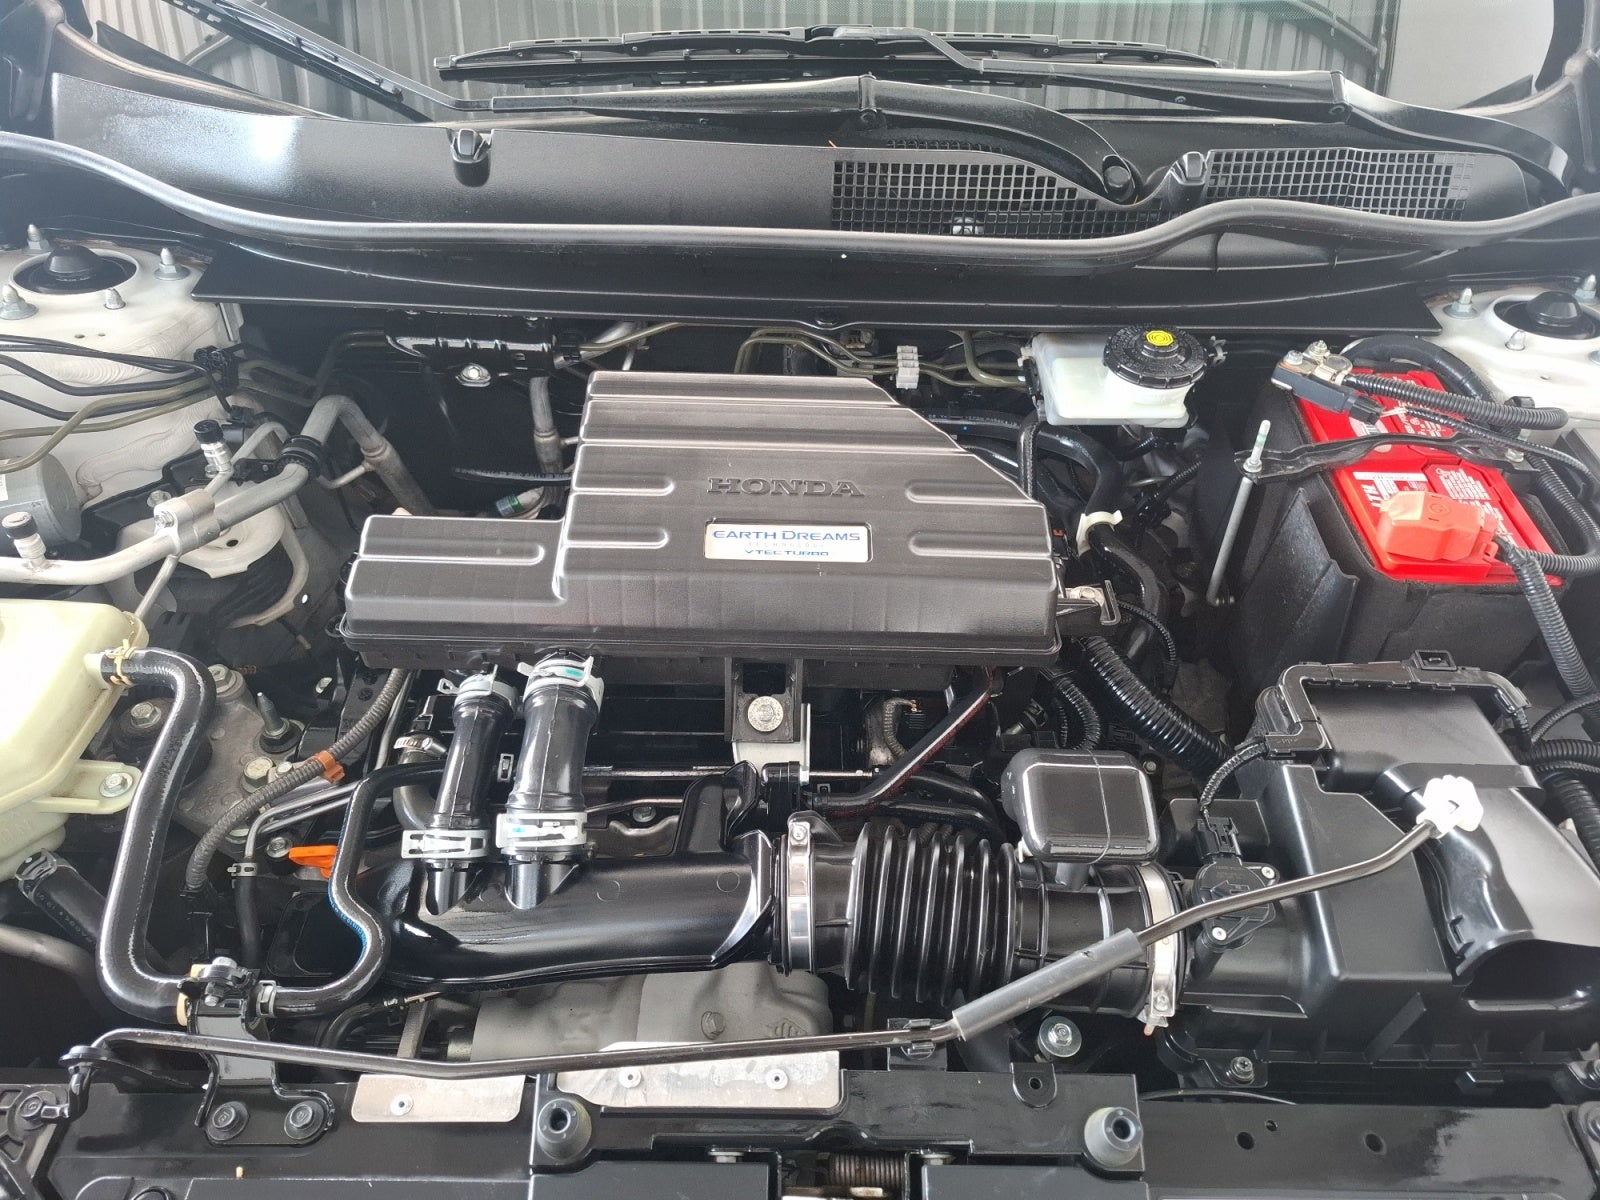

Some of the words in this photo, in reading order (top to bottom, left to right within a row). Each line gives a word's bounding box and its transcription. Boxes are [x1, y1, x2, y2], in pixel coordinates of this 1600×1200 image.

[707, 477, 865, 498] HONDA
[712, 530, 777, 540] EARTH
[782, 530, 861, 541] DREAMS
